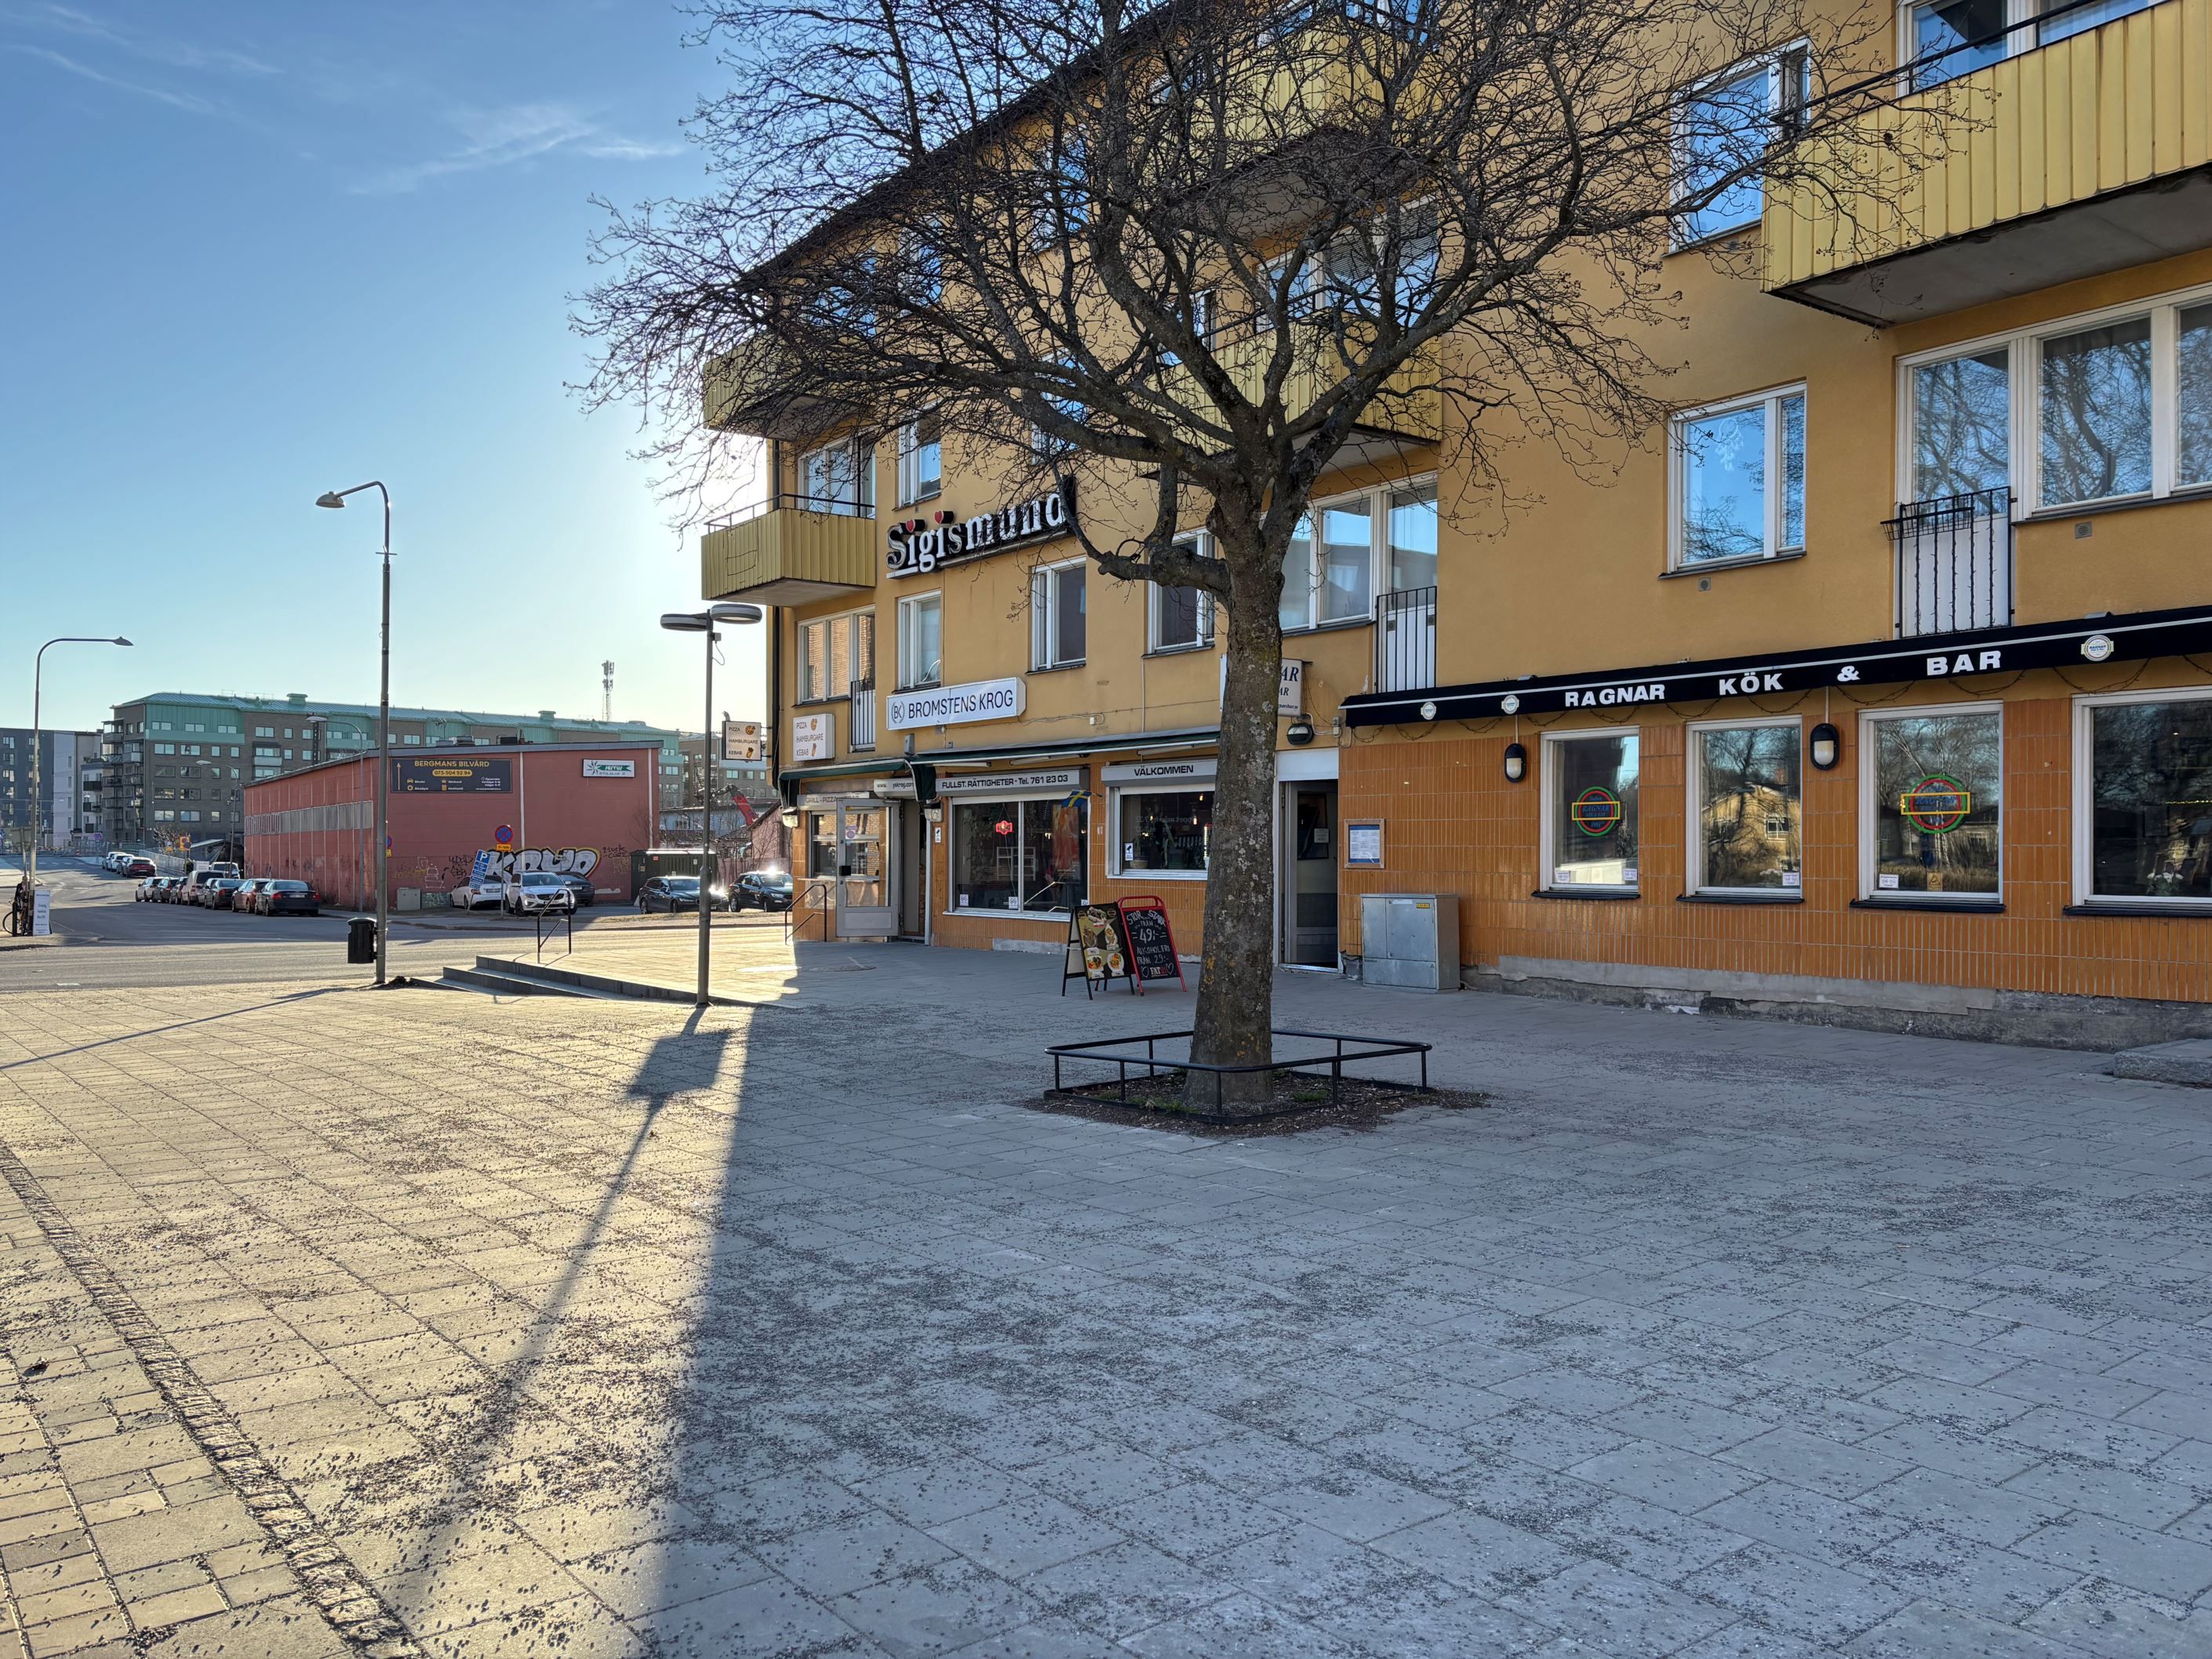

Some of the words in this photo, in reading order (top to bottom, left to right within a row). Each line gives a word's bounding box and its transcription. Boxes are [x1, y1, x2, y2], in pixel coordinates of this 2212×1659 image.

[886, 473, 1068, 573] Sigismund
[1280, 666, 1299, 682] AR
[1565, 684, 1665, 707] RAGNAR
[1719, 671, 1784, 696] KÖK
[1836, 665, 1861, 682] &
[1926, 650, 2002, 676] BAR
[1279, 686, 1289, 696] AR
[908, 695, 977, 719] BROMSTENS
[979, 689, 1013, 711] KROG
[796, 733, 824, 742] HAMBURGARE
[1133, 765, 1194, 777] VÄLKOMMEN
[967, 777, 1014, 788] RÄTTIGHETER
[1126, 910, 1144, 925] STOR
